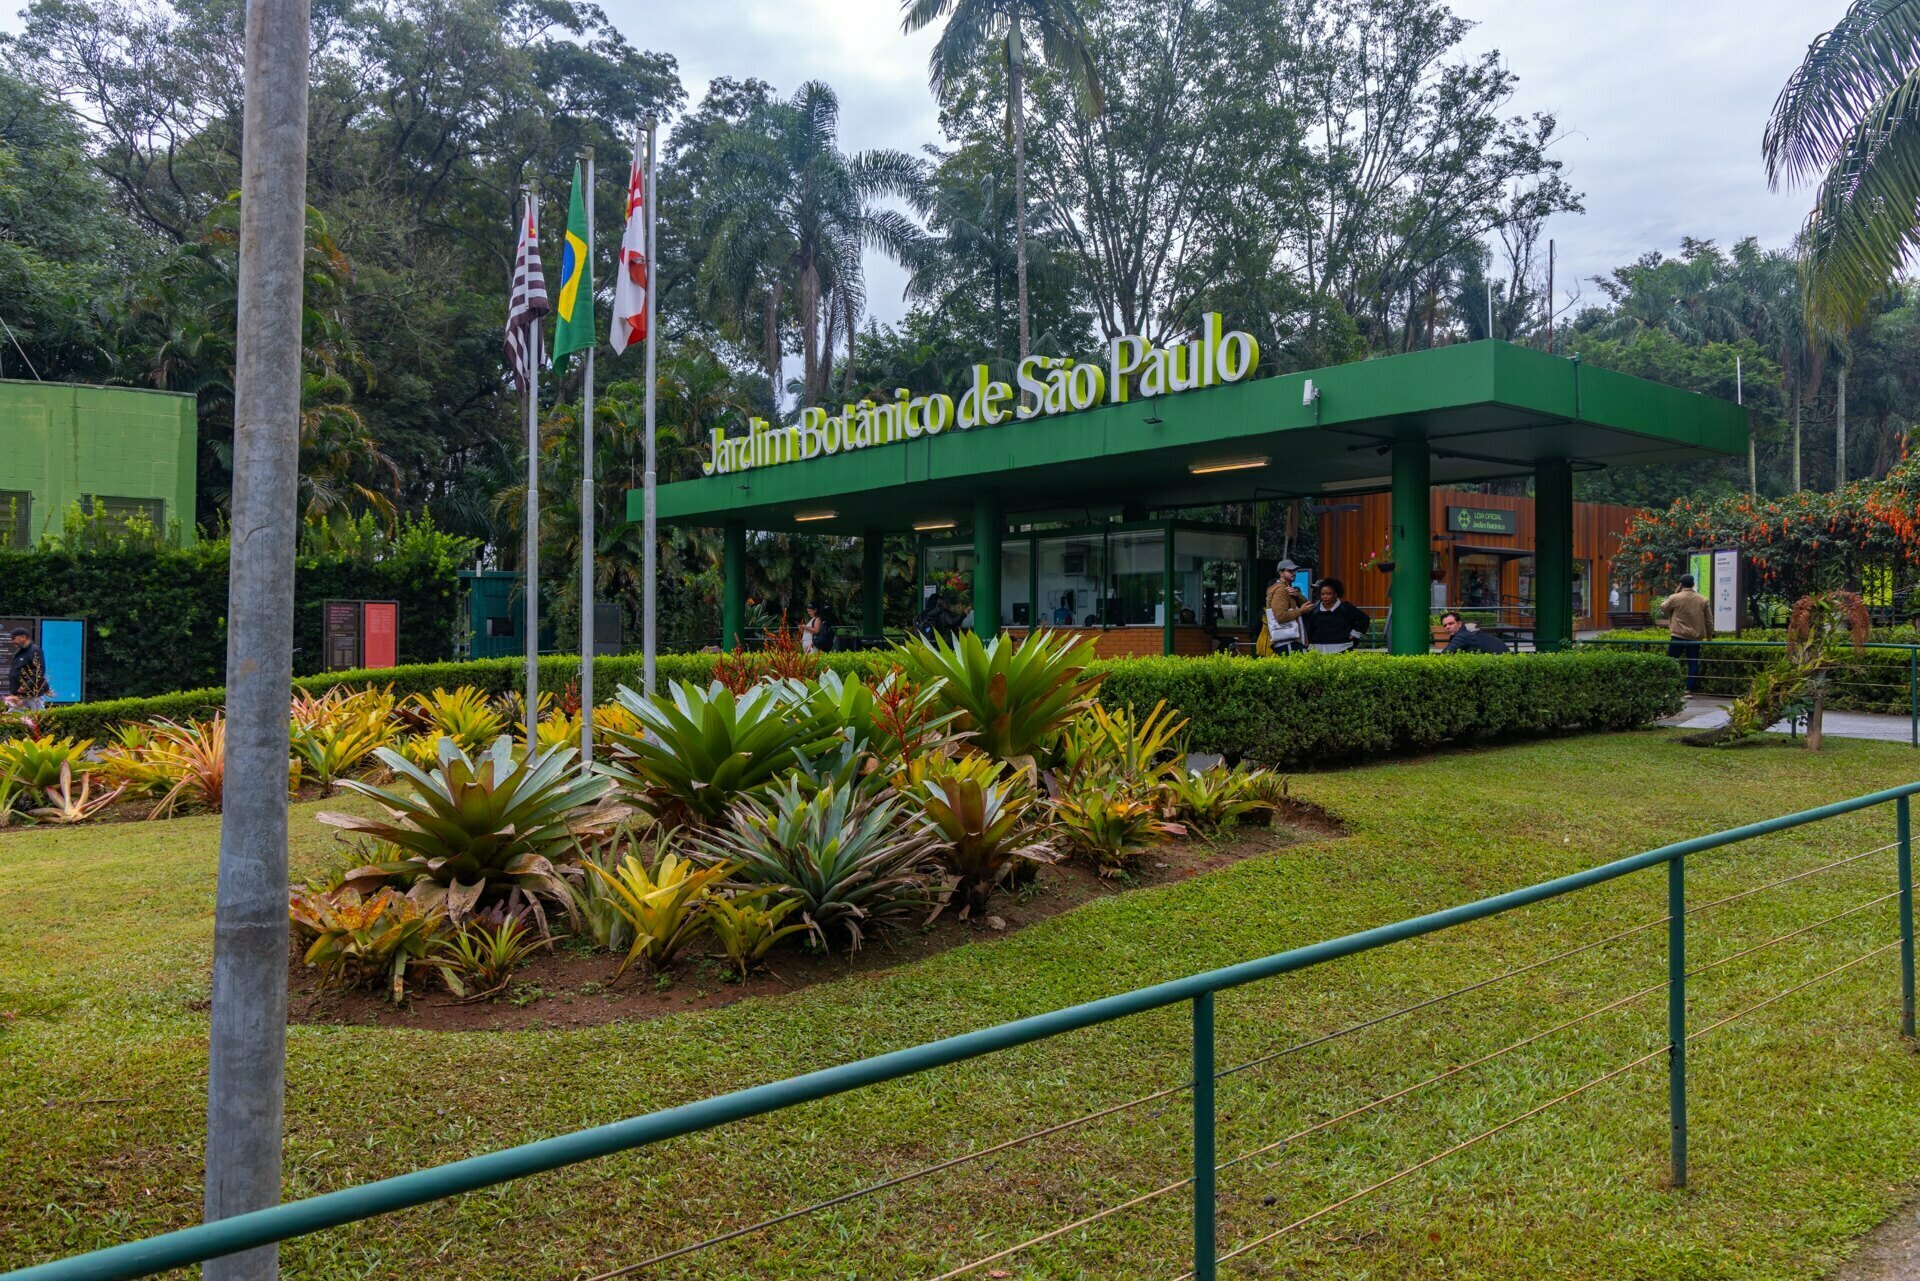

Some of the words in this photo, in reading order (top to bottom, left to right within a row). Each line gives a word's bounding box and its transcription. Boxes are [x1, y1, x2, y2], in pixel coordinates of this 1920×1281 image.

[702, 417, 799, 475] Jardim
[800, 388, 954, 459] Botânico
[957, 364, 1012, 429] de
[1016, 355, 1104, 419] São
[1110, 311, 1260, 403] Paulo
